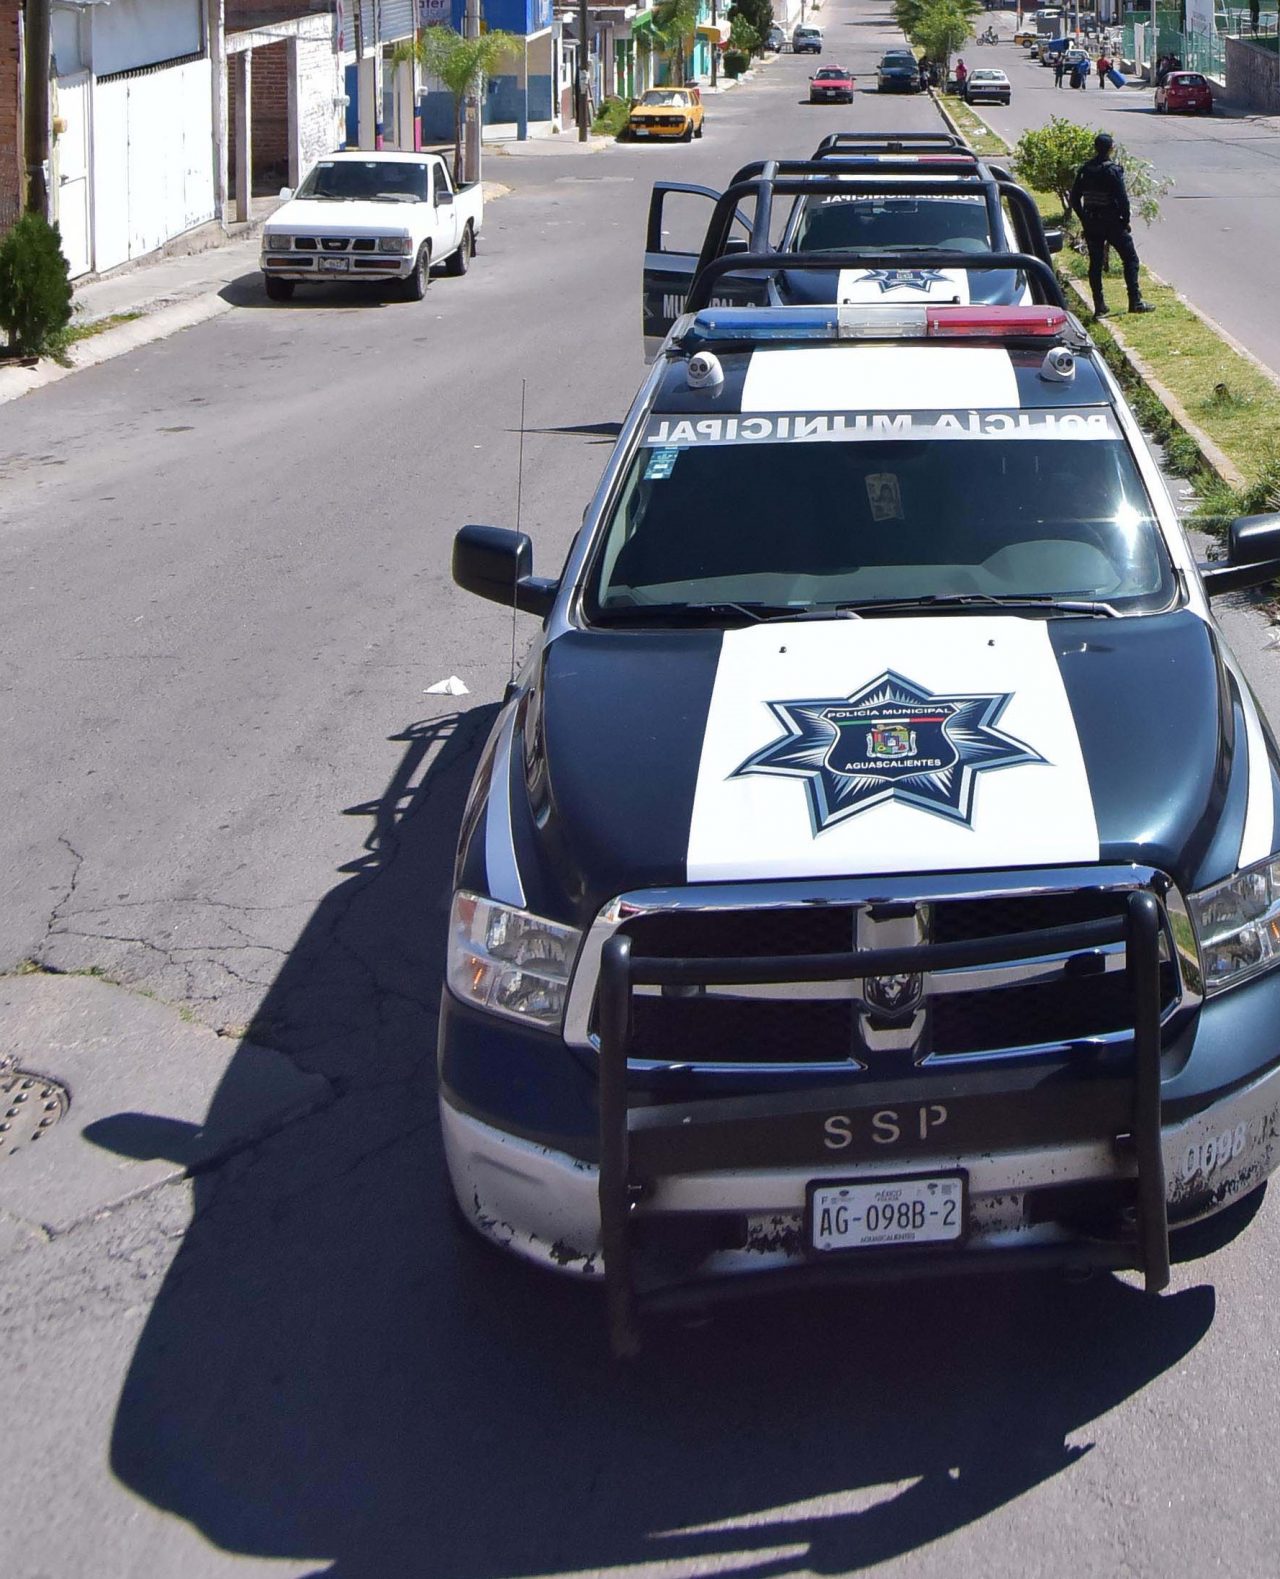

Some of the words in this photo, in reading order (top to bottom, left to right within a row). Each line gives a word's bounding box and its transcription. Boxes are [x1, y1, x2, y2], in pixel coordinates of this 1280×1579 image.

[882, 708, 952, 716] MUNICIPAL
[845, 759, 941, 770] AGUASCALIENTES
[819, 1200, 956, 1237] AG-098B-2
